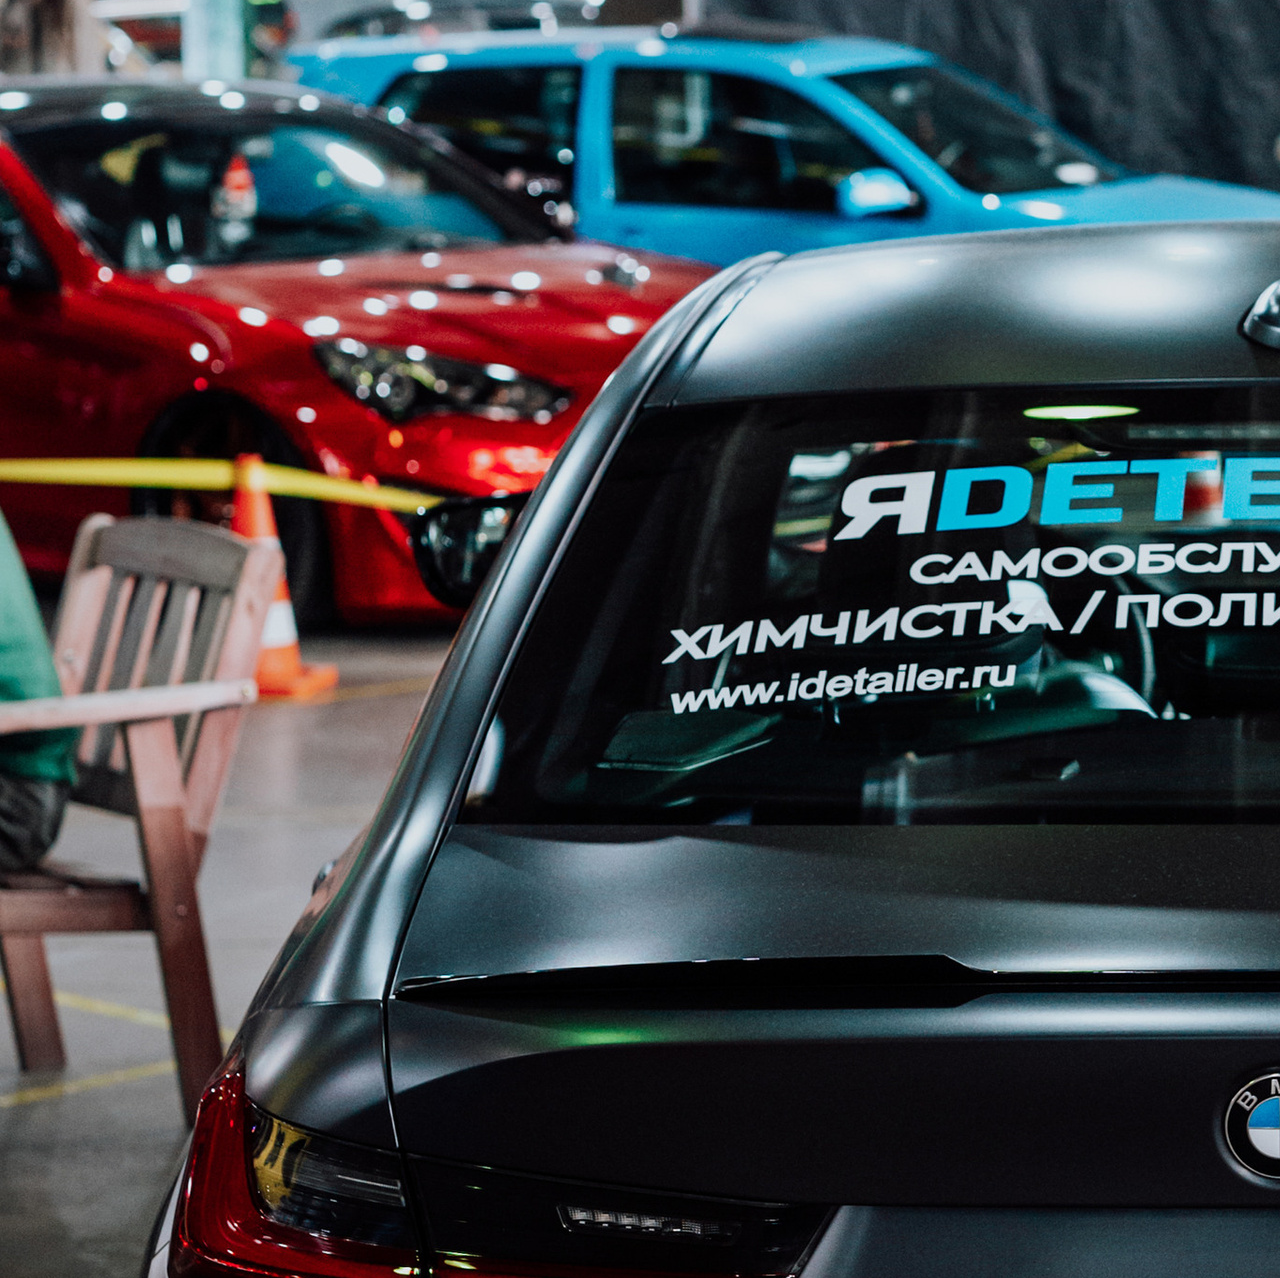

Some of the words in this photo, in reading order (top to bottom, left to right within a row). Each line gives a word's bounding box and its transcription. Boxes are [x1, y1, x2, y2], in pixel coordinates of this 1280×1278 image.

[661, 599, 1064, 665] ХИМЧИСТКА
[1070, 590, 1107, 635] /
[669, 659, 1018, 715] www.idetailer.ru
